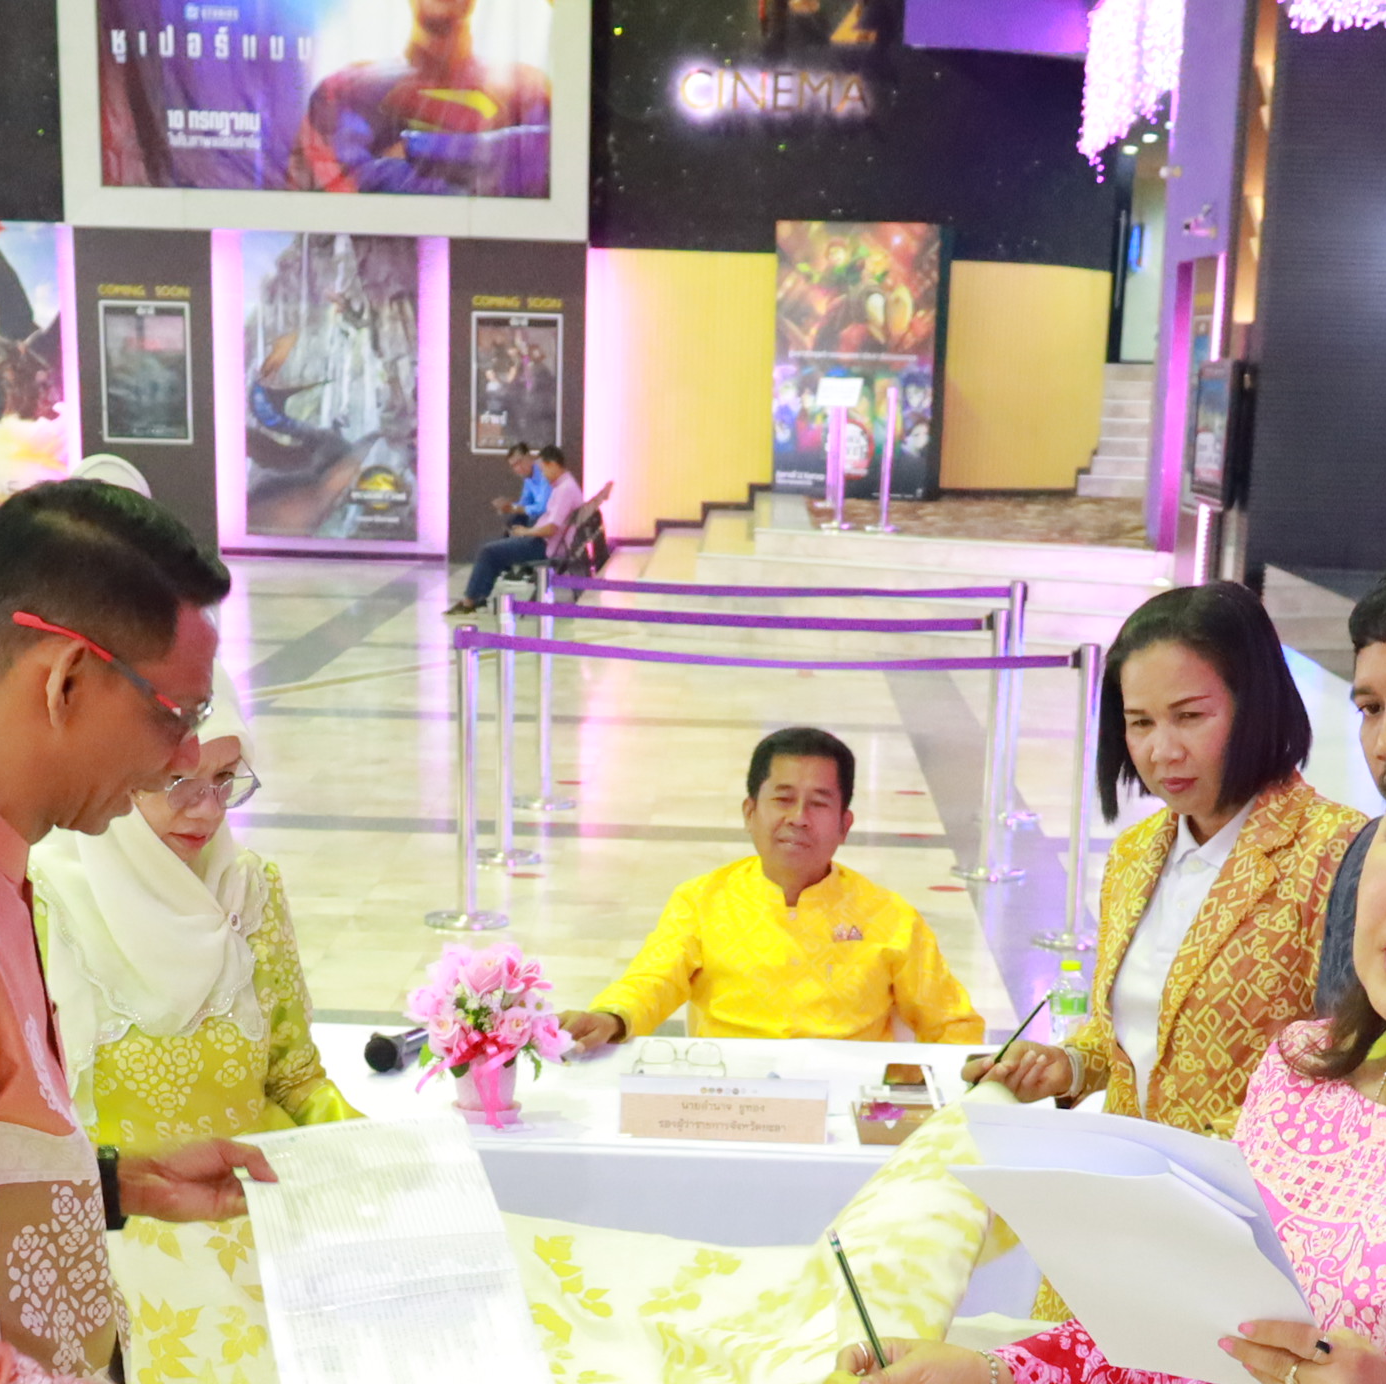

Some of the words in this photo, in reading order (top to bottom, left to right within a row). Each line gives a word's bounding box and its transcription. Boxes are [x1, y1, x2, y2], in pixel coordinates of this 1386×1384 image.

[679, 68, 869, 115] CINEMA
[97, 283, 146, 297] COMING
[154, 285, 192, 298] SOON
[471, 294, 521, 309] COMING
[527, 296, 563, 309] SOON
